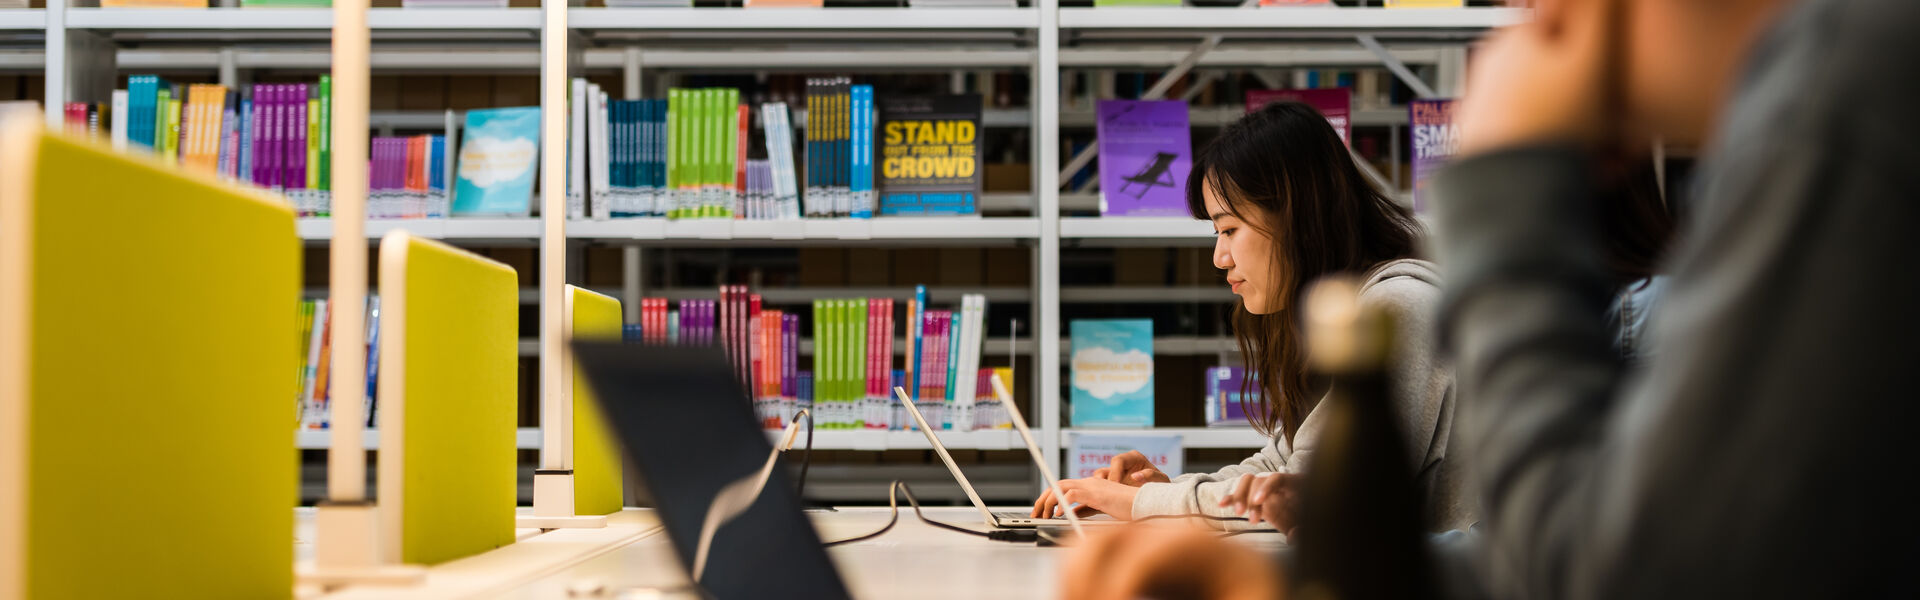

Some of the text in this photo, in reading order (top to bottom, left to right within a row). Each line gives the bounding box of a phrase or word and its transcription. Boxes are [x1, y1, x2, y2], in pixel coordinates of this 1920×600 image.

[885, 121, 976, 144] STAND
[1415, 124, 1460, 146] SMA
[884, 144, 976, 157] OUT FROM THE
[883, 156, 975, 178] CROWD
